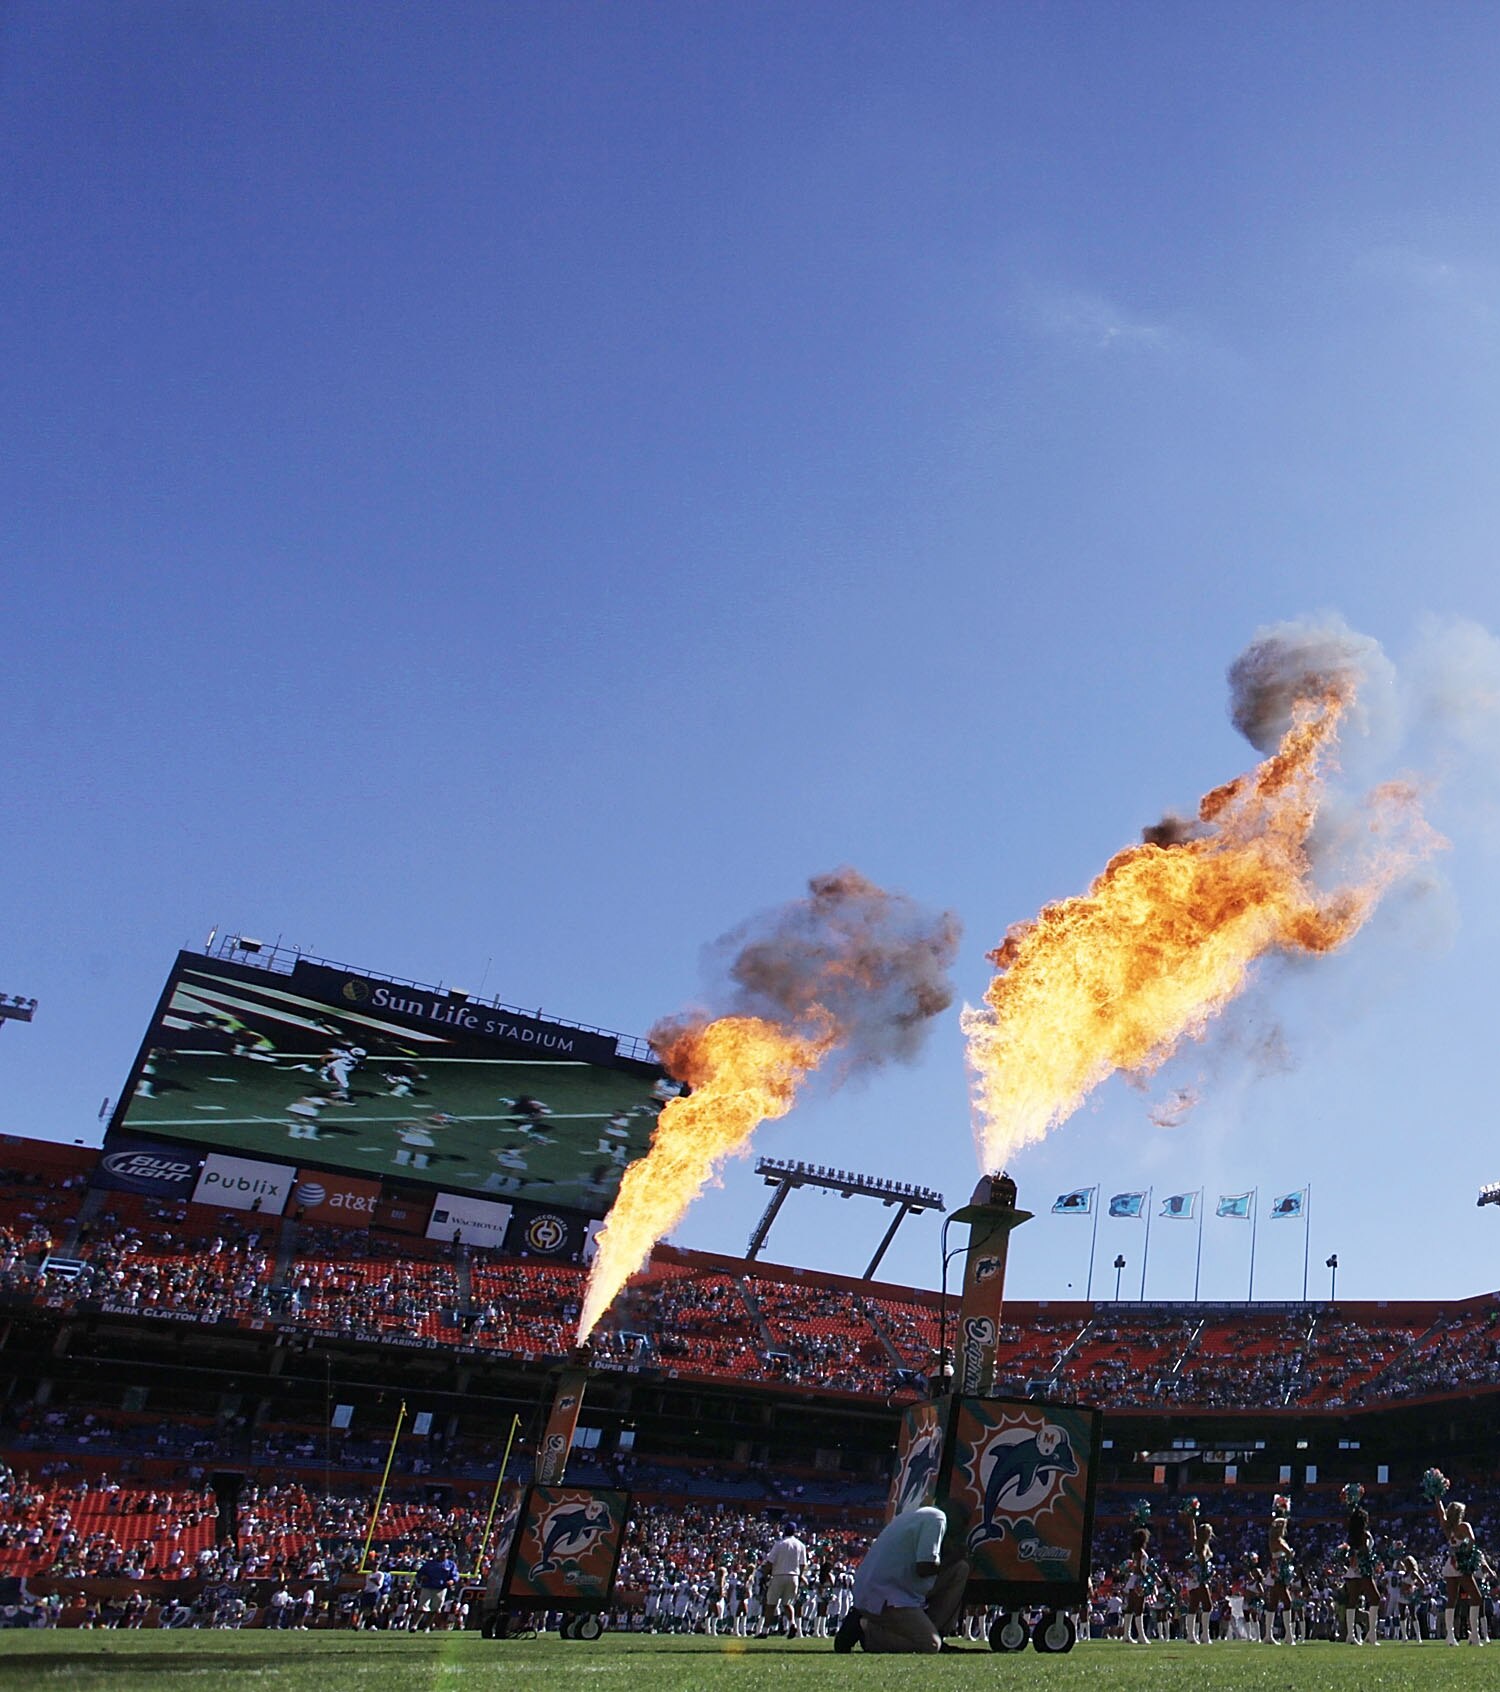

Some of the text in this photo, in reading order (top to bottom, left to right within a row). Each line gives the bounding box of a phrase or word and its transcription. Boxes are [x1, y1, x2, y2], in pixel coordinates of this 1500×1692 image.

[371, 987, 574, 1052] Sun Life STADIUM
[112, 1161, 192, 1183] LIGHT
[130, 1155, 191, 1173] BUD
[204, 1171, 280, 1197] Publix
[328, 1190, 378, 1214] at&t
[451, 1216, 504, 1233] WACHOVIA
[101, 1303, 218, 1325] MARK CLAYTON 83
[355, 1332, 379, 1344] DAN
[381, 1336, 423, 1349] MARINO
[426, 1340, 438, 1350] 13
[594, 1360, 624, 1372] DUPER
[1043, 1432, 1055, 1445] M
